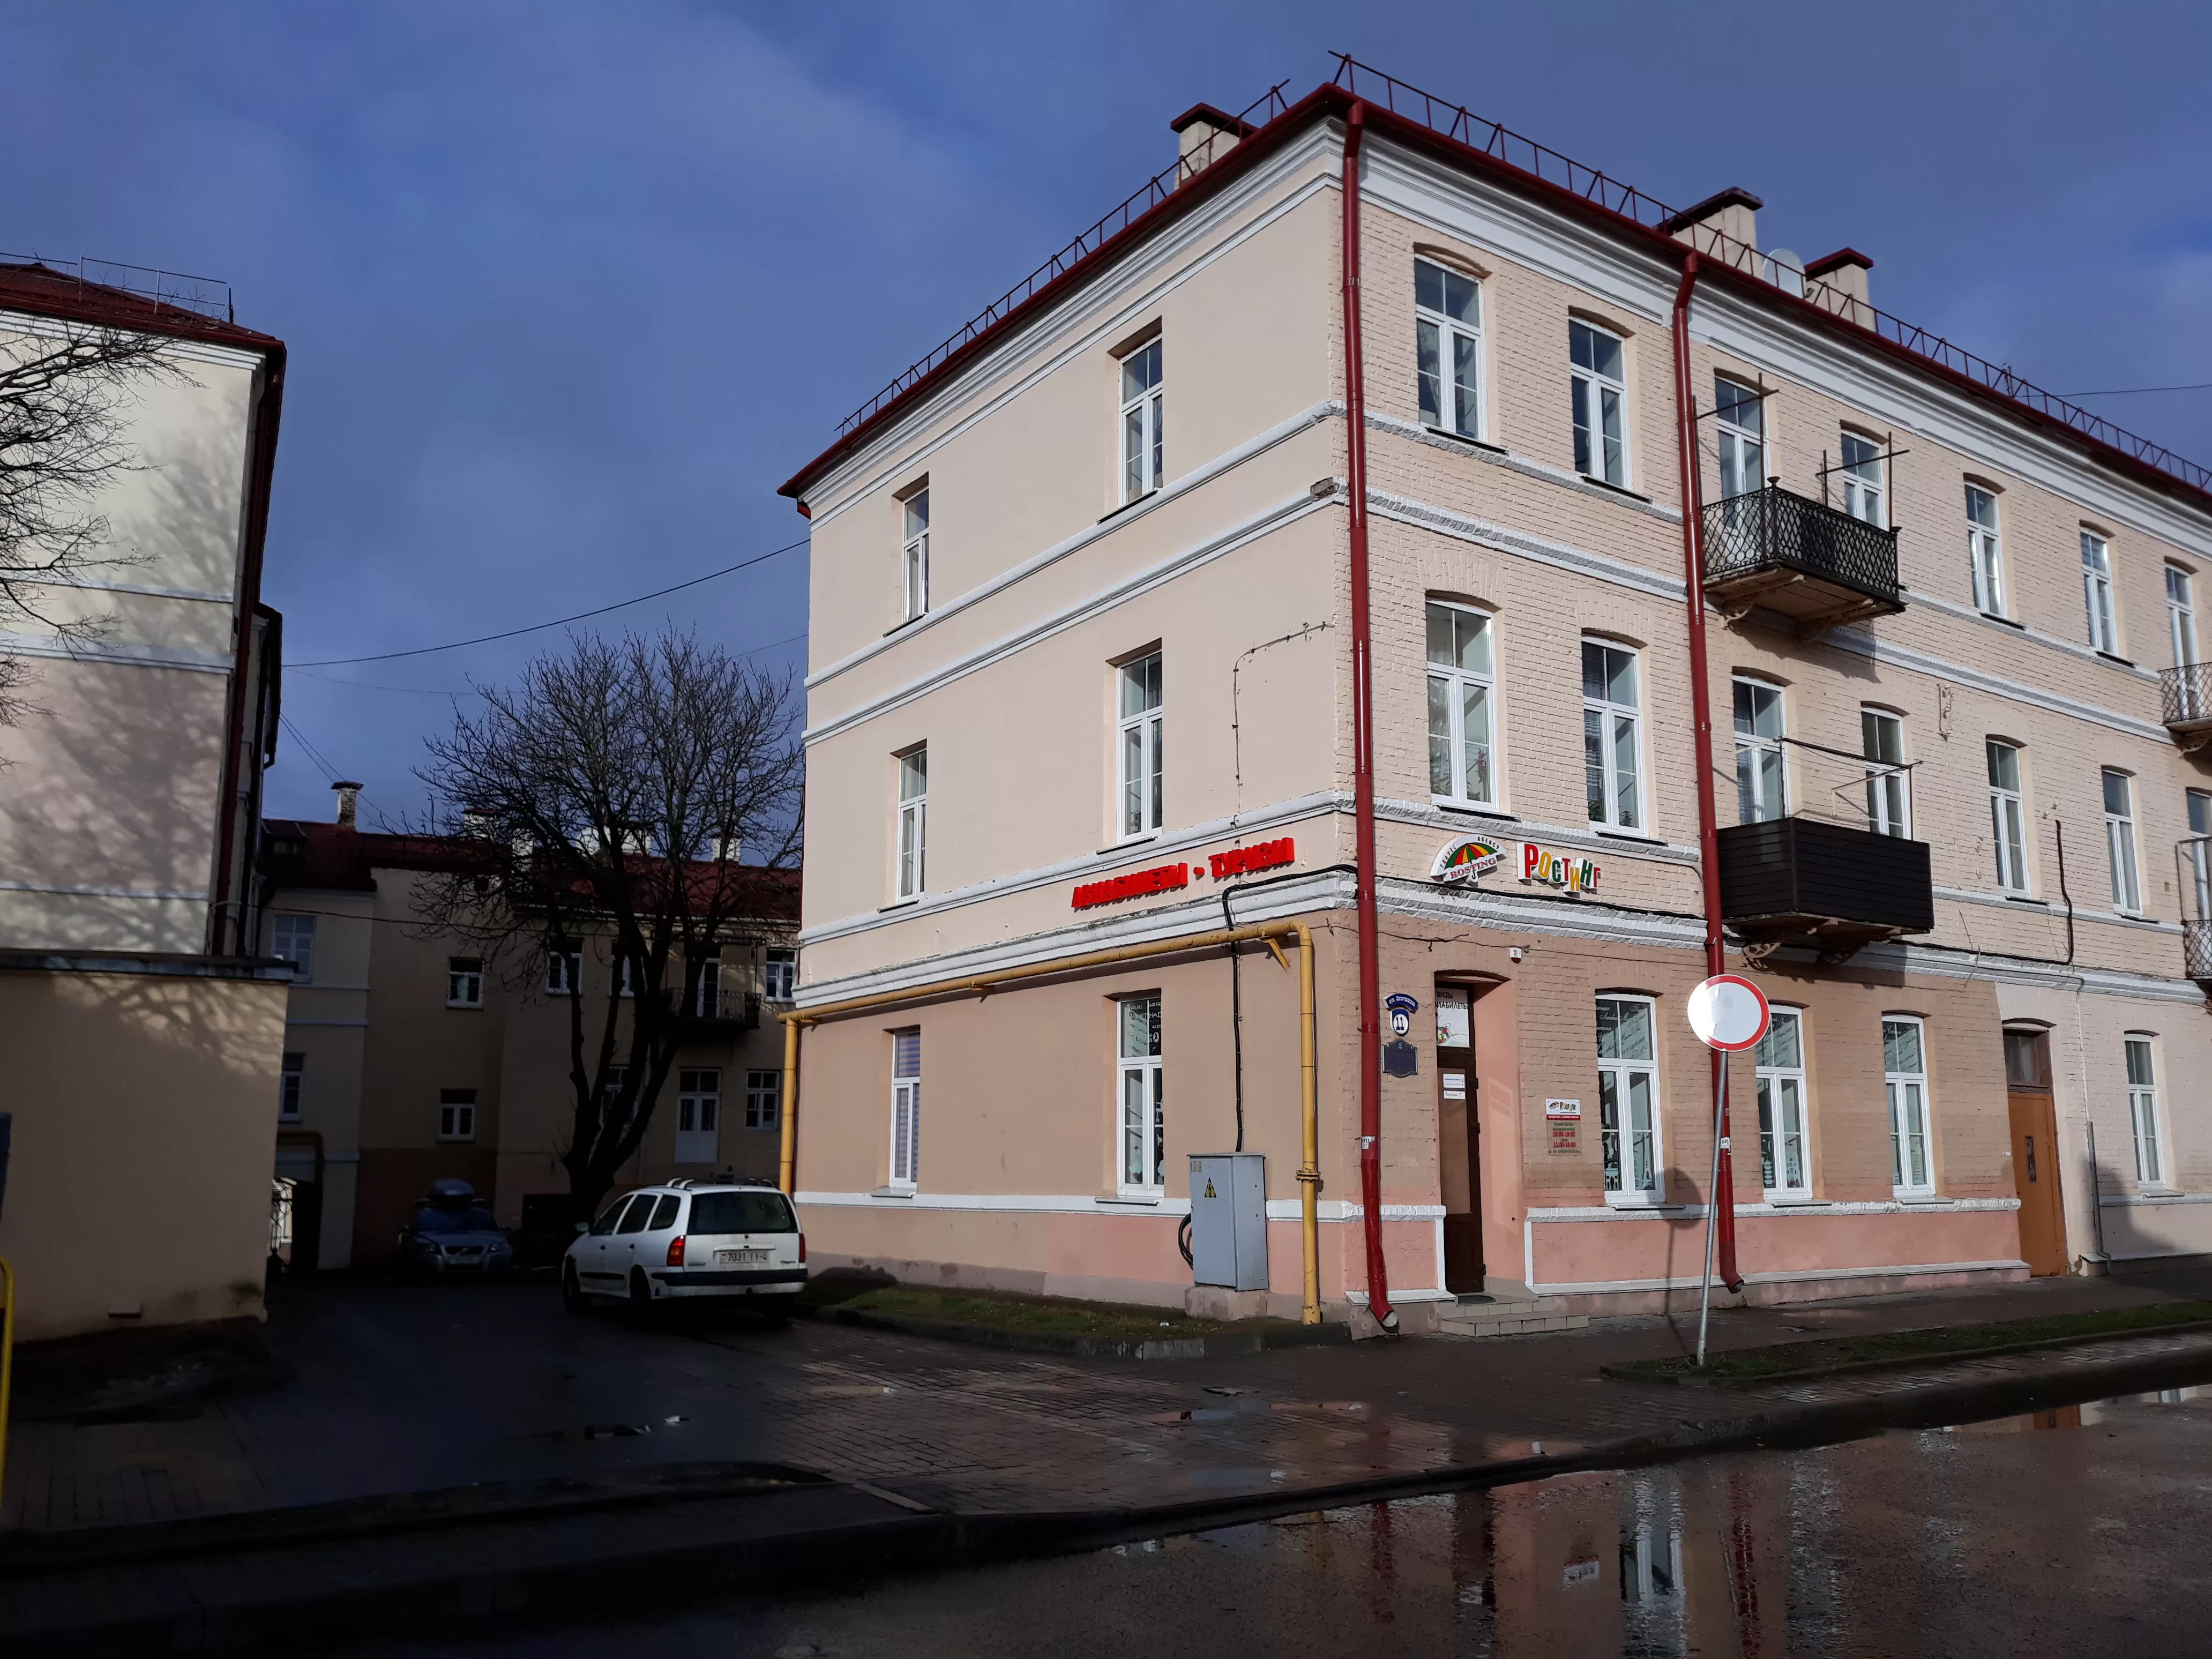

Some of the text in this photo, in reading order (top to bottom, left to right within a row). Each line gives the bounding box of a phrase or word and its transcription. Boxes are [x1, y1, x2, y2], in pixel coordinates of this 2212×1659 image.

[1440, 836, 1500, 869] TRAVEL AGENCY
[1450, 857, 1496, 879] ROSTING
[1437, 990, 1453, 999] ВИЗЫ
[1396, 1017, 1404, 1030] 11
